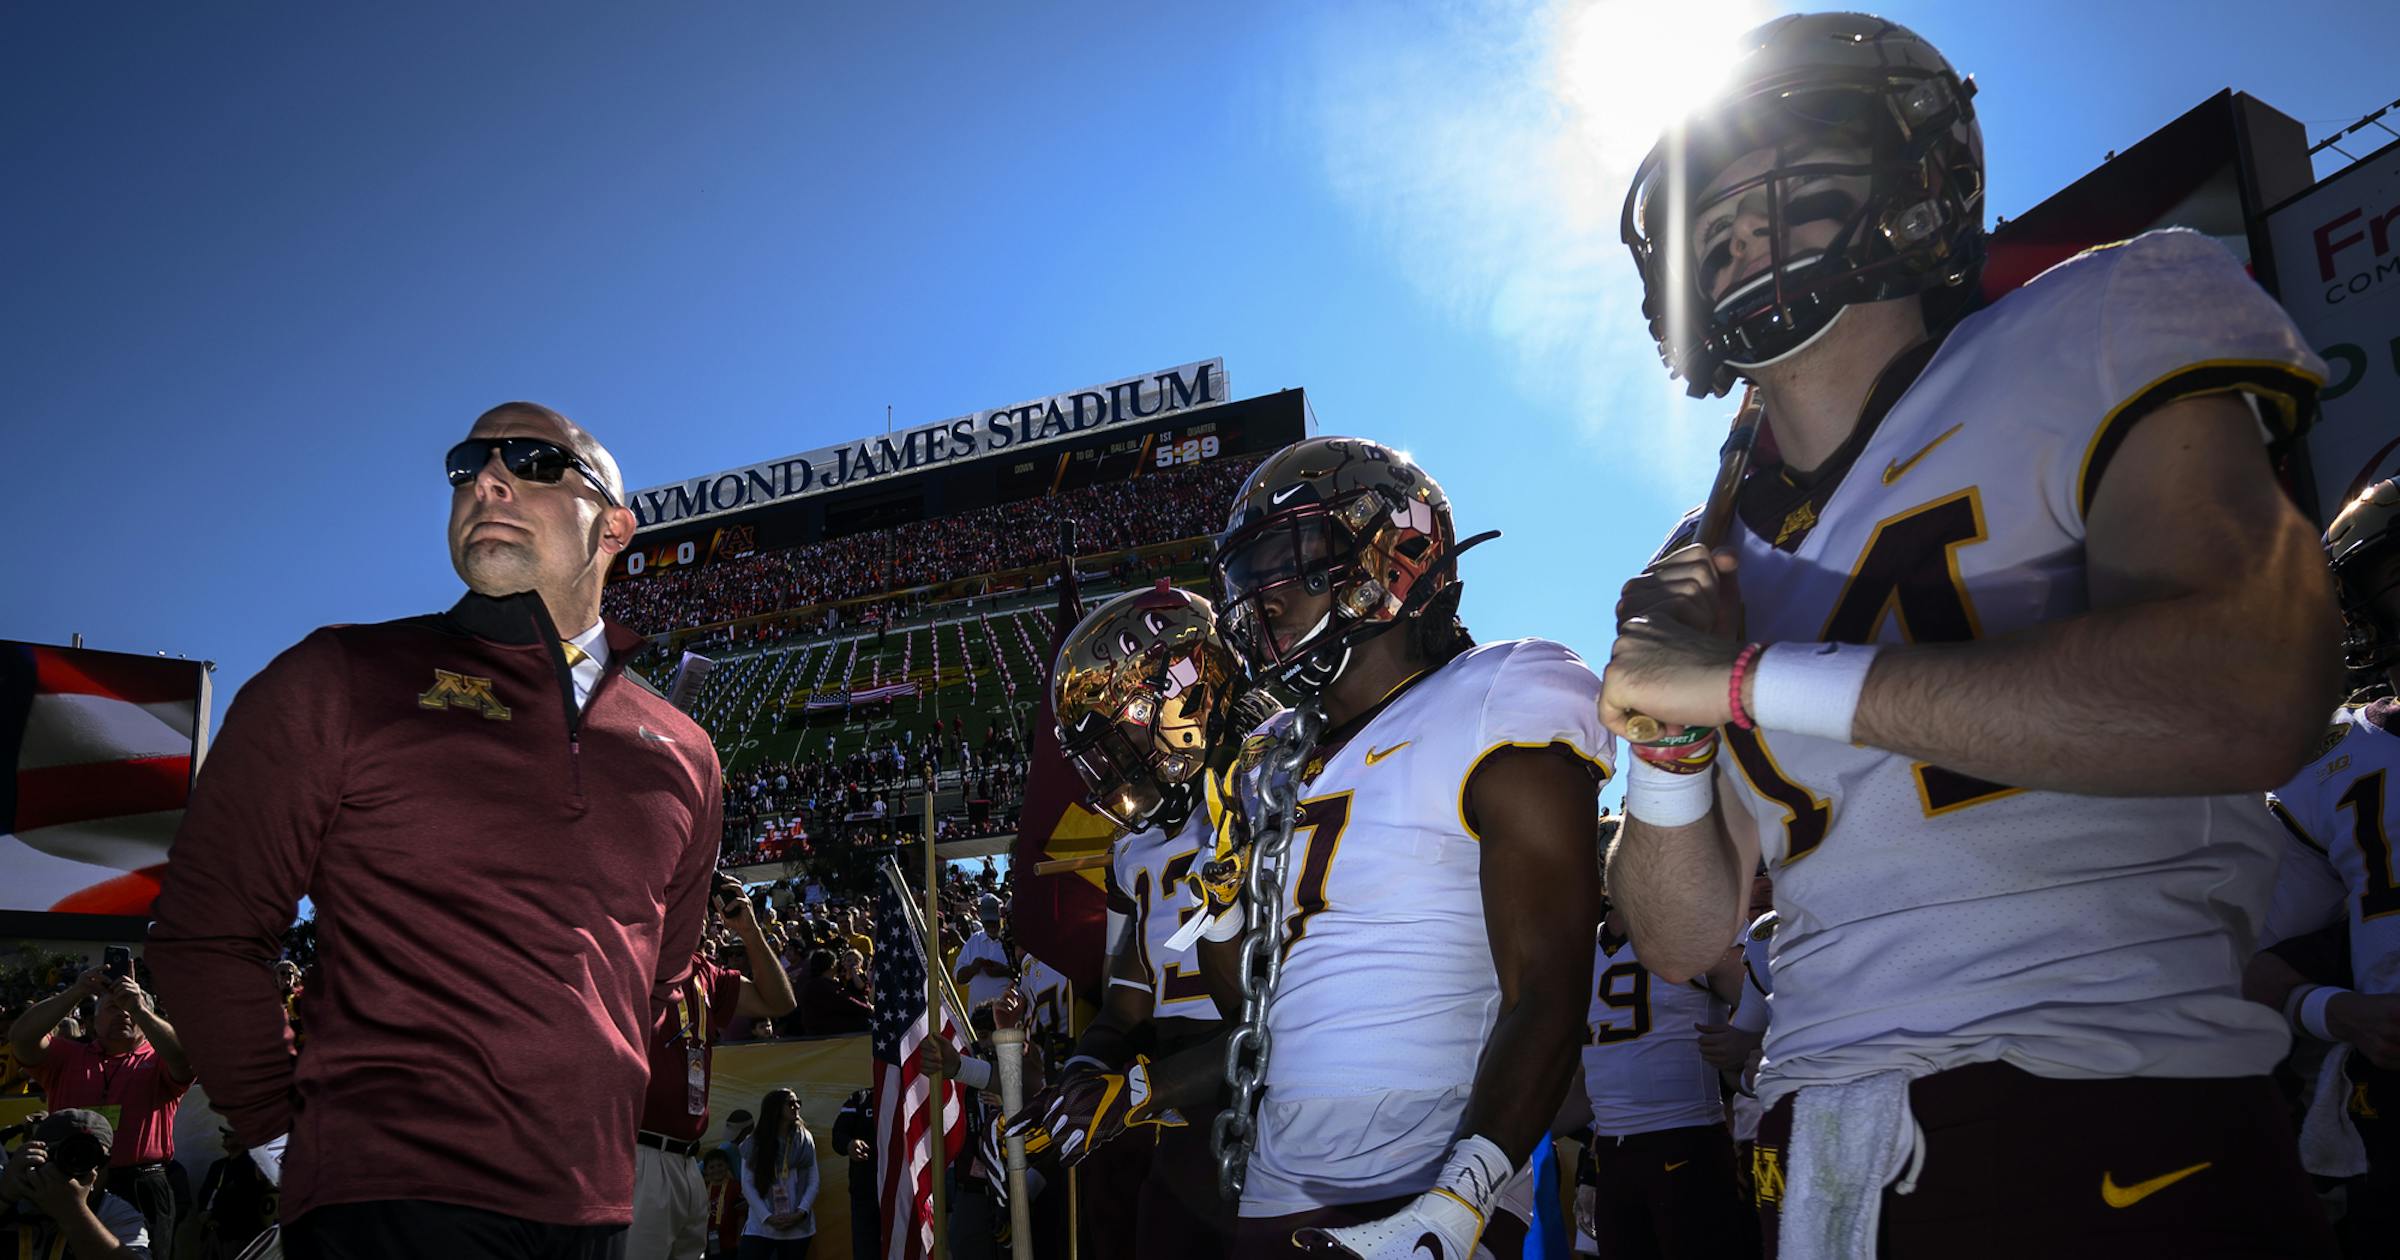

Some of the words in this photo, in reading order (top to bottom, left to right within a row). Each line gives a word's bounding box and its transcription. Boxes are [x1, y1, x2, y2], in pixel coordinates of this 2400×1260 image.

[629, 459, 813, 528] AYMOND
[820, 415, 974, 487] JAMES
[988, 364, 1215, 449] STADIUM
[1159, 432, 1173, 443] 1ST
[1186, 422, 1217, 438] QUARTER
[1156, 435, 1220, 468] 5:29
[627, 552, 645, 576] 0
[677, 540, 695, 565] 0
[418, 667, 512, 721] M
[1586, 960, 1653, 1046] 9
